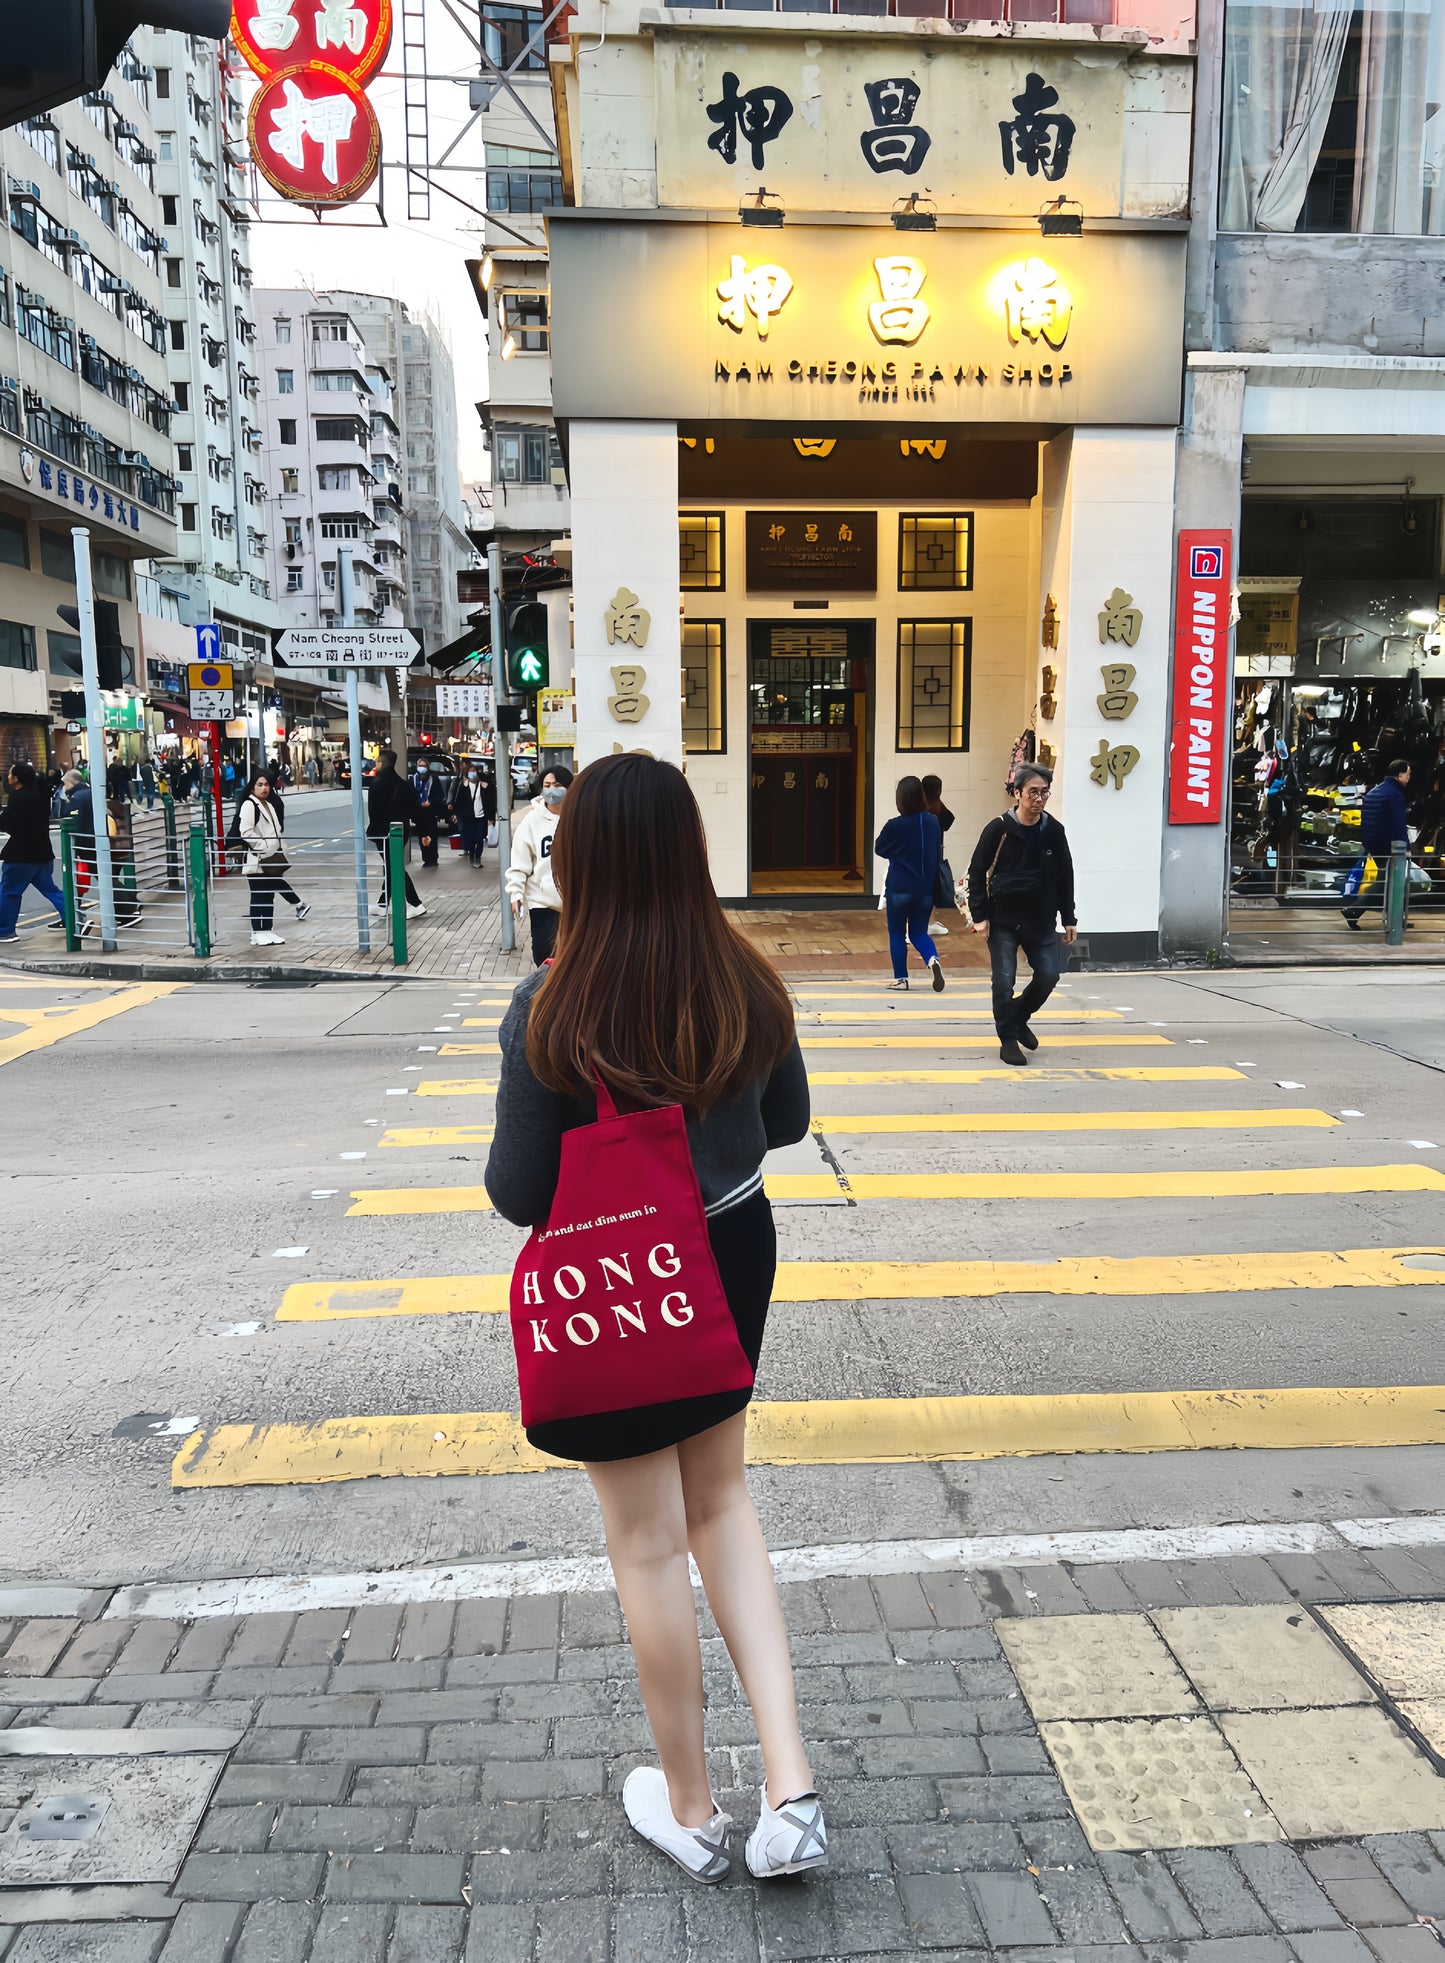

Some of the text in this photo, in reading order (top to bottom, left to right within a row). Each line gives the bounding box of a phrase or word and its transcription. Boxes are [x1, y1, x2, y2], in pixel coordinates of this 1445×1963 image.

[268, 78, 357, 185] 押
[714, 359, 1073, 386] NAM CHEONG PAWN SHOP
[291, 633, 404, 644] Nam Cheong Street
[217, 691, 225, 701] 7
[604, 586, 655, 757] 南昌
[1089, 586, 1144, 791] 南昌押
[1186, 590, 1217, 808] NIPPON PAINT
[218, 708, 231, 718] 12
[554, 1223, 574, 1237] and
[576, 1220, 594, 1231] eat
[595, 1215, 618, 1226] dim
[619, 1209, 643, 1221] sum
[644, 1205, 657, 1215] in
[523, 1242, 683, 1305] HONG
[529, 1291, 695, 1352] KONG
